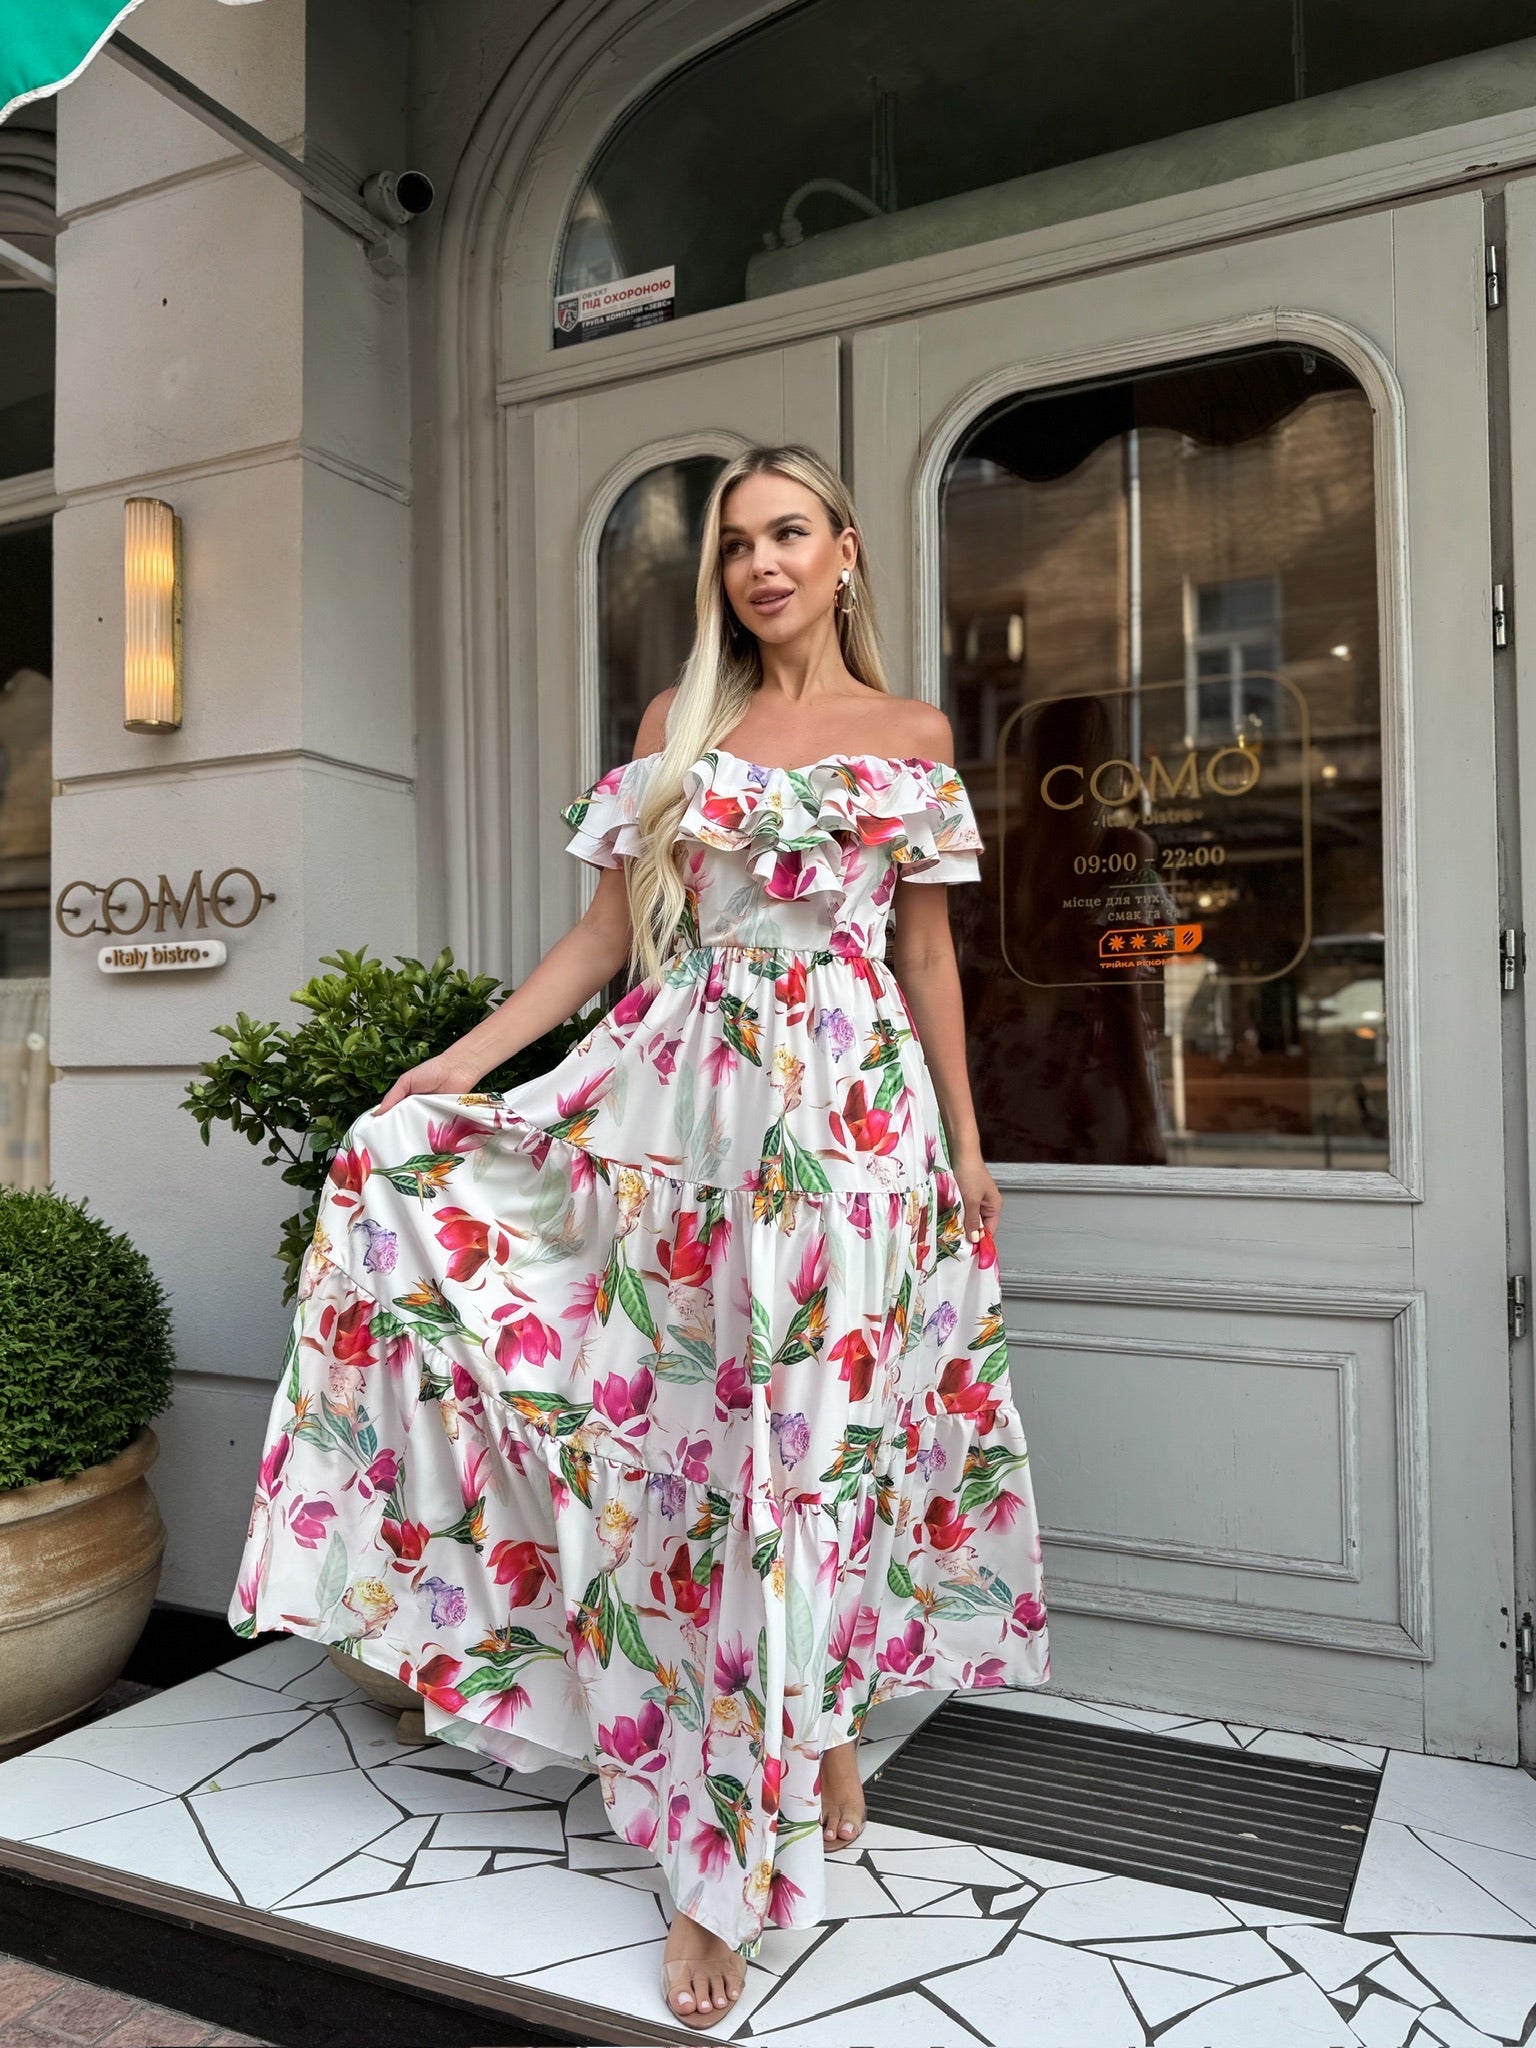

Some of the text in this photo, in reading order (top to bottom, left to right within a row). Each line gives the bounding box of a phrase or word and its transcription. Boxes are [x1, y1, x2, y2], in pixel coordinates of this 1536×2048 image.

[582, 299, 600, 311] ПІД
[603, 279, 671, 305] ОХОРОНОЮ
[582, 317, 605, 329] ГРУПА
[606, 306, 643, 322] КОМПАНІЙ
[1040, 747, 1261, 811] COMO
[1073, 852, 1137, 875] 09:00
[1162, 846, 1226, 869] 22:00
[56, 866, 262, 938] COMO
[1062, 896, 1101, 909] місце
[1106, 896, 1131, 908] для
[1107, 911, 1141, 922] смак
[112, 945, 200, 969] Italy bistro
[1100, 959, 1136, 969] ТРІЙКА
